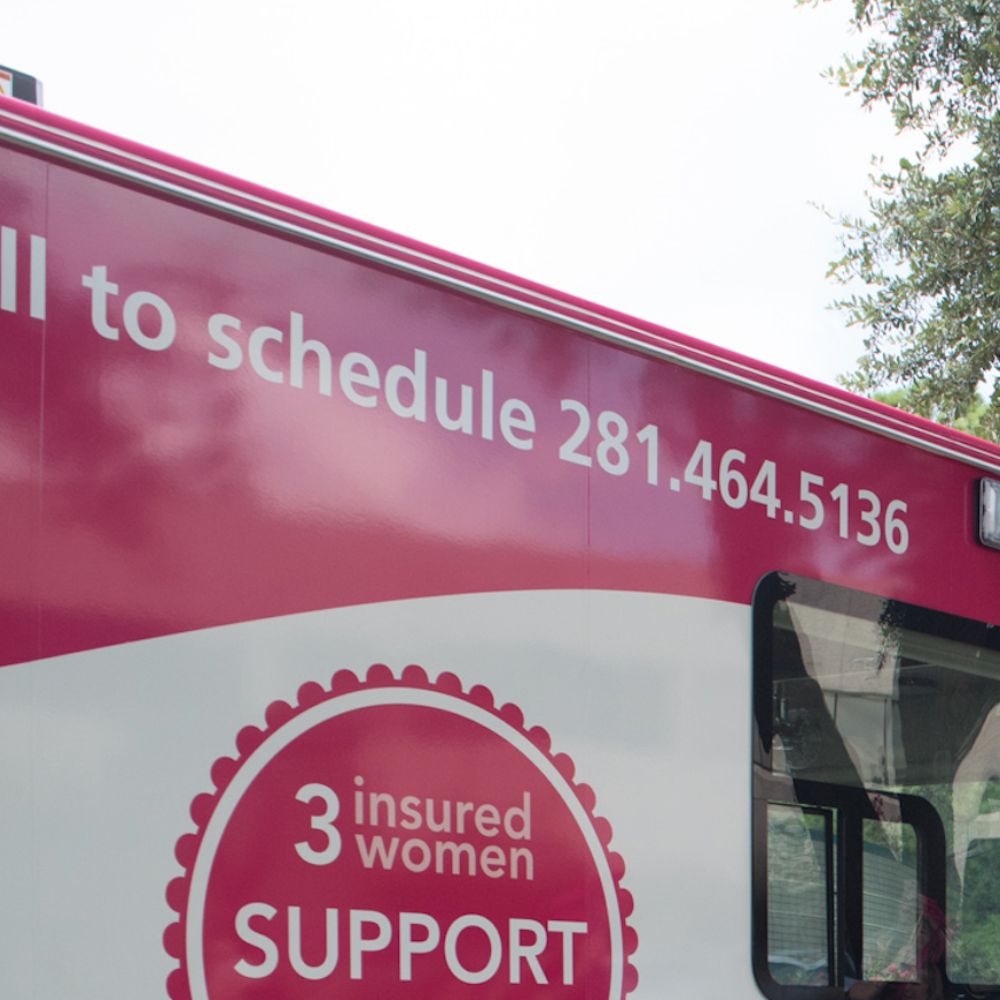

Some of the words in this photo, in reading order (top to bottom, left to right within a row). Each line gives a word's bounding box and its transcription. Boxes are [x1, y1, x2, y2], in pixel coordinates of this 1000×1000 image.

[82, 265, 176, 351] to
[207, 311, 536, 451] schedule
[559, 399, 908, 554] 281.464.5136
[294, 783, 342, 866] 3
[353, 776, 532, 841] insured
[355, 831, 535, 880] women
[233, 902, 588, 985] SUPPORT
